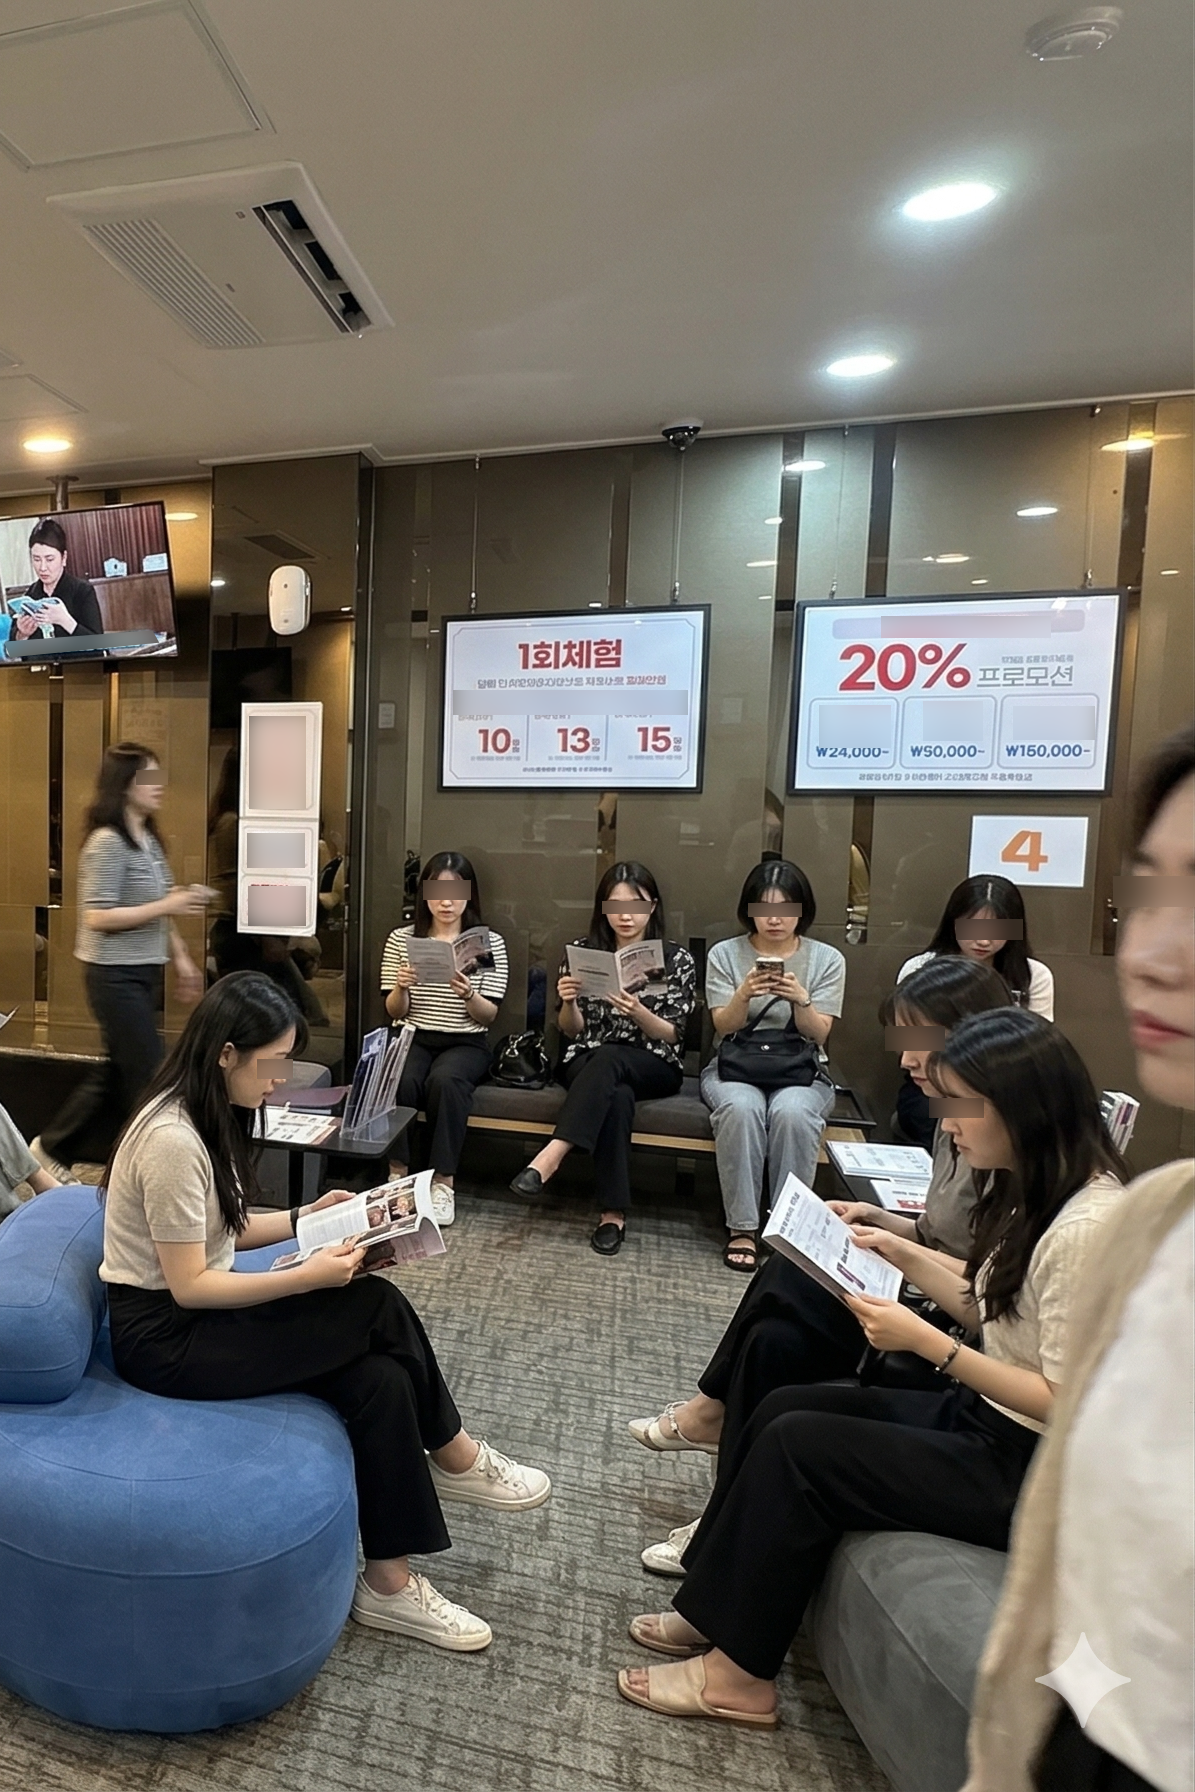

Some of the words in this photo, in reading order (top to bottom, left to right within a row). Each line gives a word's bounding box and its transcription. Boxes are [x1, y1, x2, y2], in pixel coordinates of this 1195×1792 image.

[518, 639, 622, 670] 1회체험
[839, 643, 971, 691] 20%
[977, 665, 1073, 688] 프로모션
[478, 728, 511, 754] 10
[557, 727, 590, 753] 13
[637, 726, 671, 752] 15
[1001, 830, 1048, 872] 4
